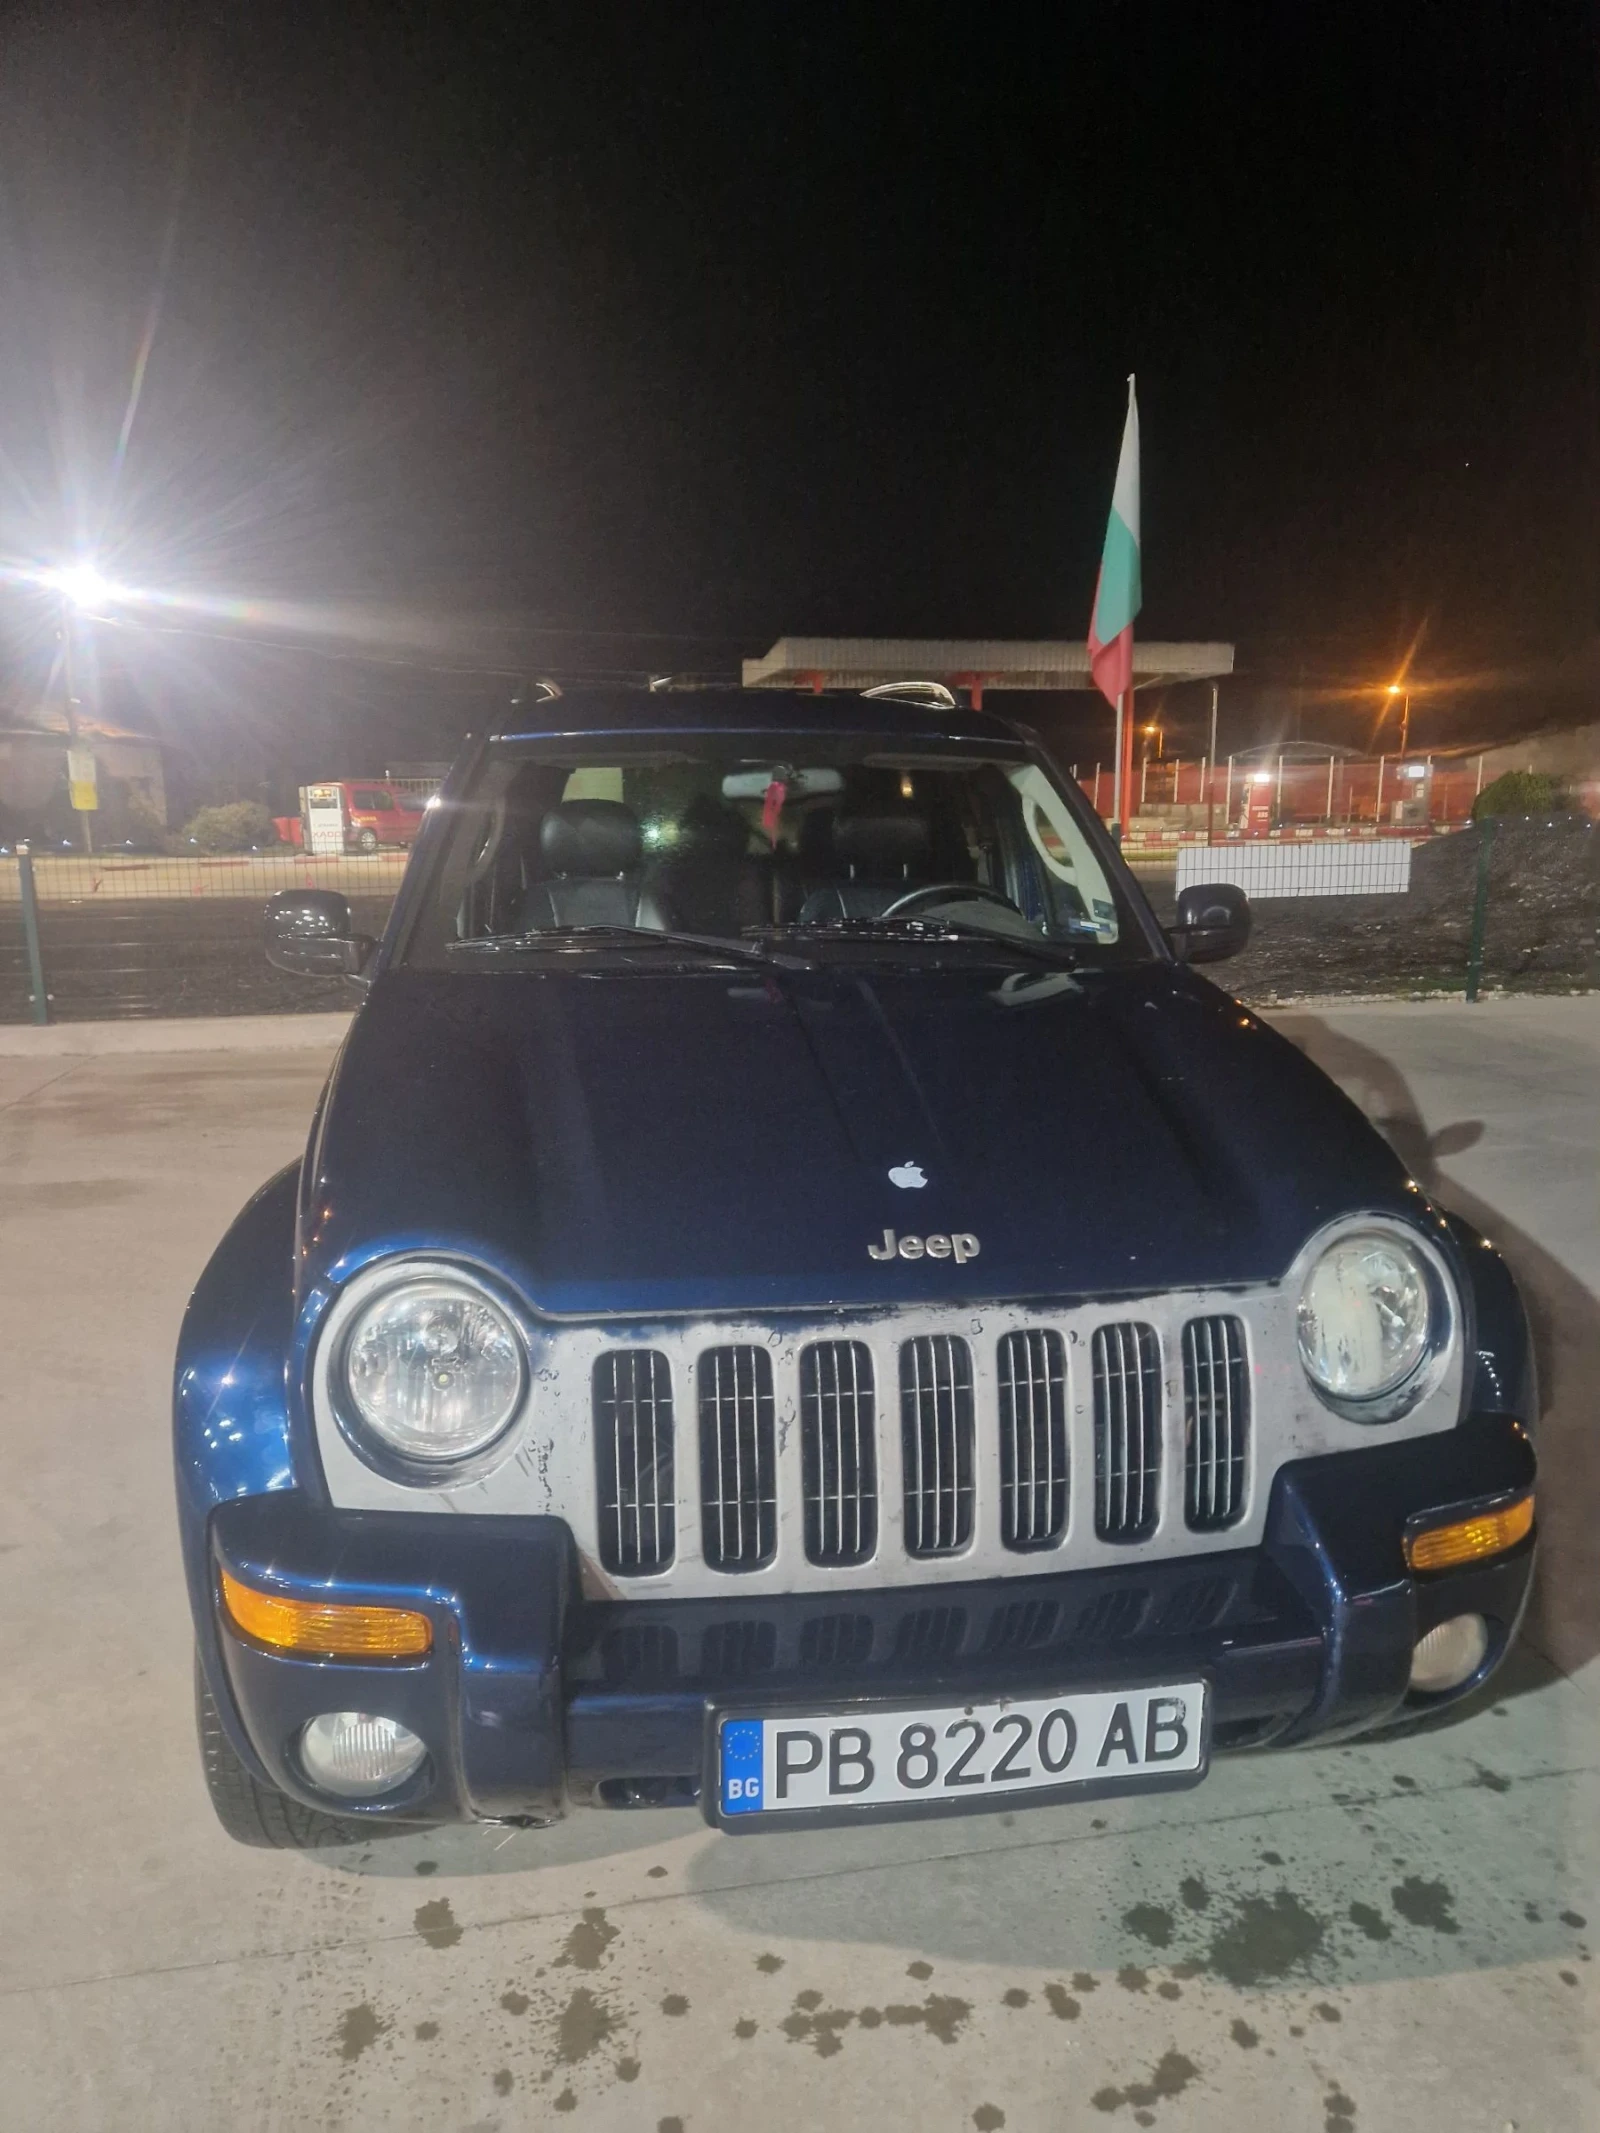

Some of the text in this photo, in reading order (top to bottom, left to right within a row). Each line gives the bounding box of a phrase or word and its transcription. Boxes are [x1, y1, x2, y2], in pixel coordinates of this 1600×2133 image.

[867, 1228, 981, 1264] Jeep
[775, 1697, 1188, 1799] PB 8220 AB
[728, 1777, 760, 1799] BG
